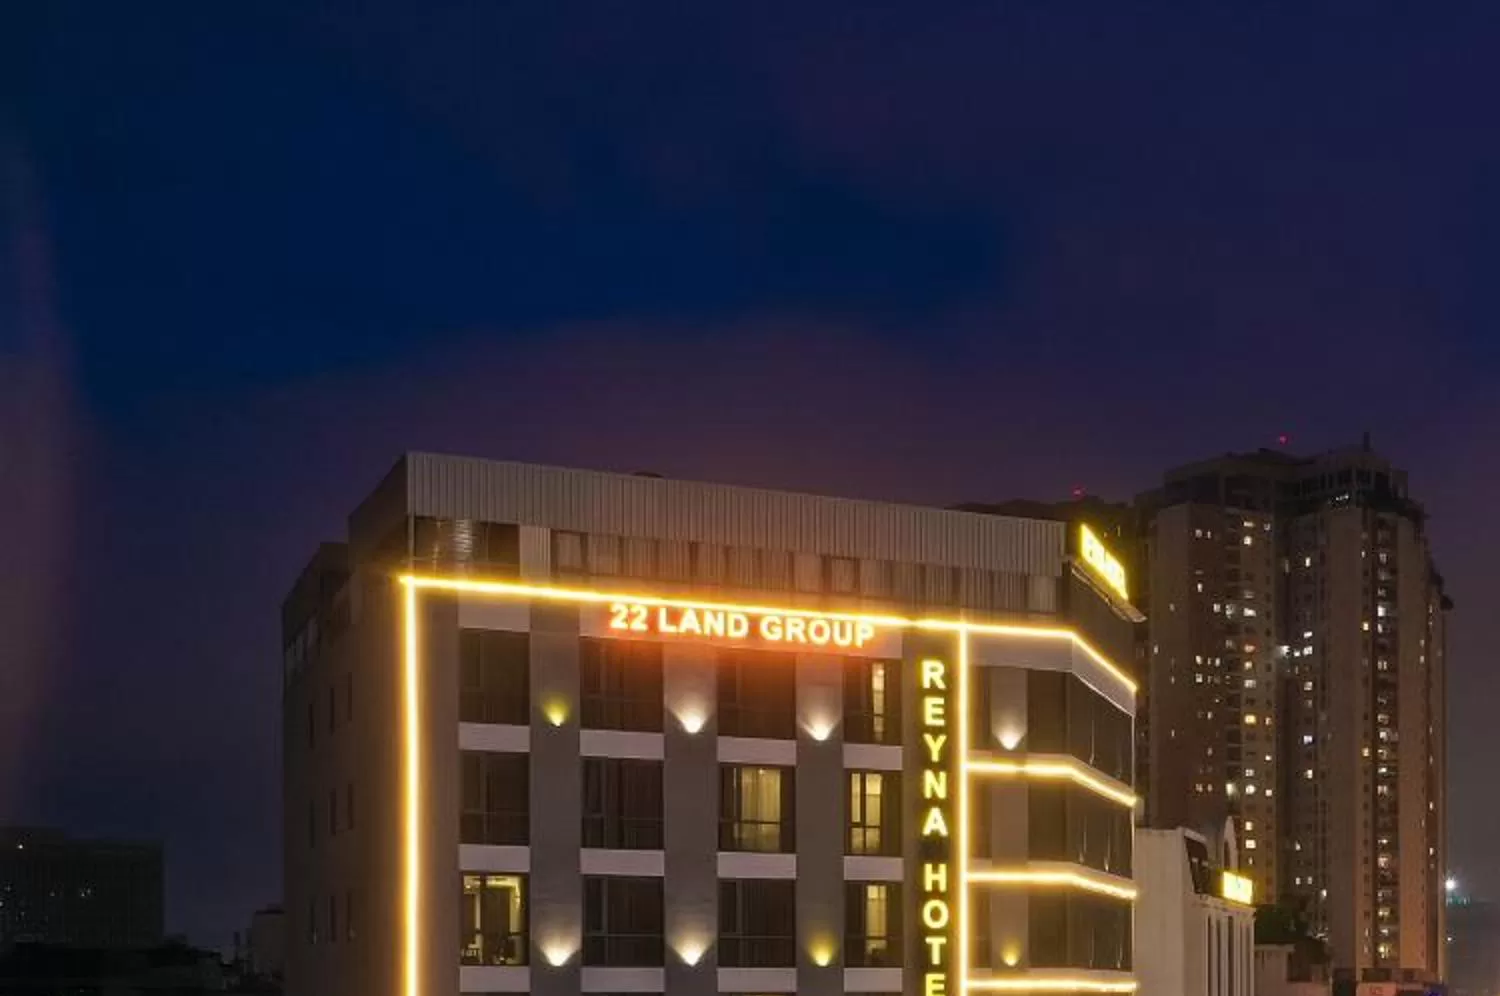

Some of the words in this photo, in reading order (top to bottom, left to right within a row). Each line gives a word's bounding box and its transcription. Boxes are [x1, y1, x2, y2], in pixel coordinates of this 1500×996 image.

[610, 604, 648, 630] 22
[658, 607, 749, 638] LAND
[760, 615, 875, 648] GROUP
[921, 659, 948, 837] REYNA
